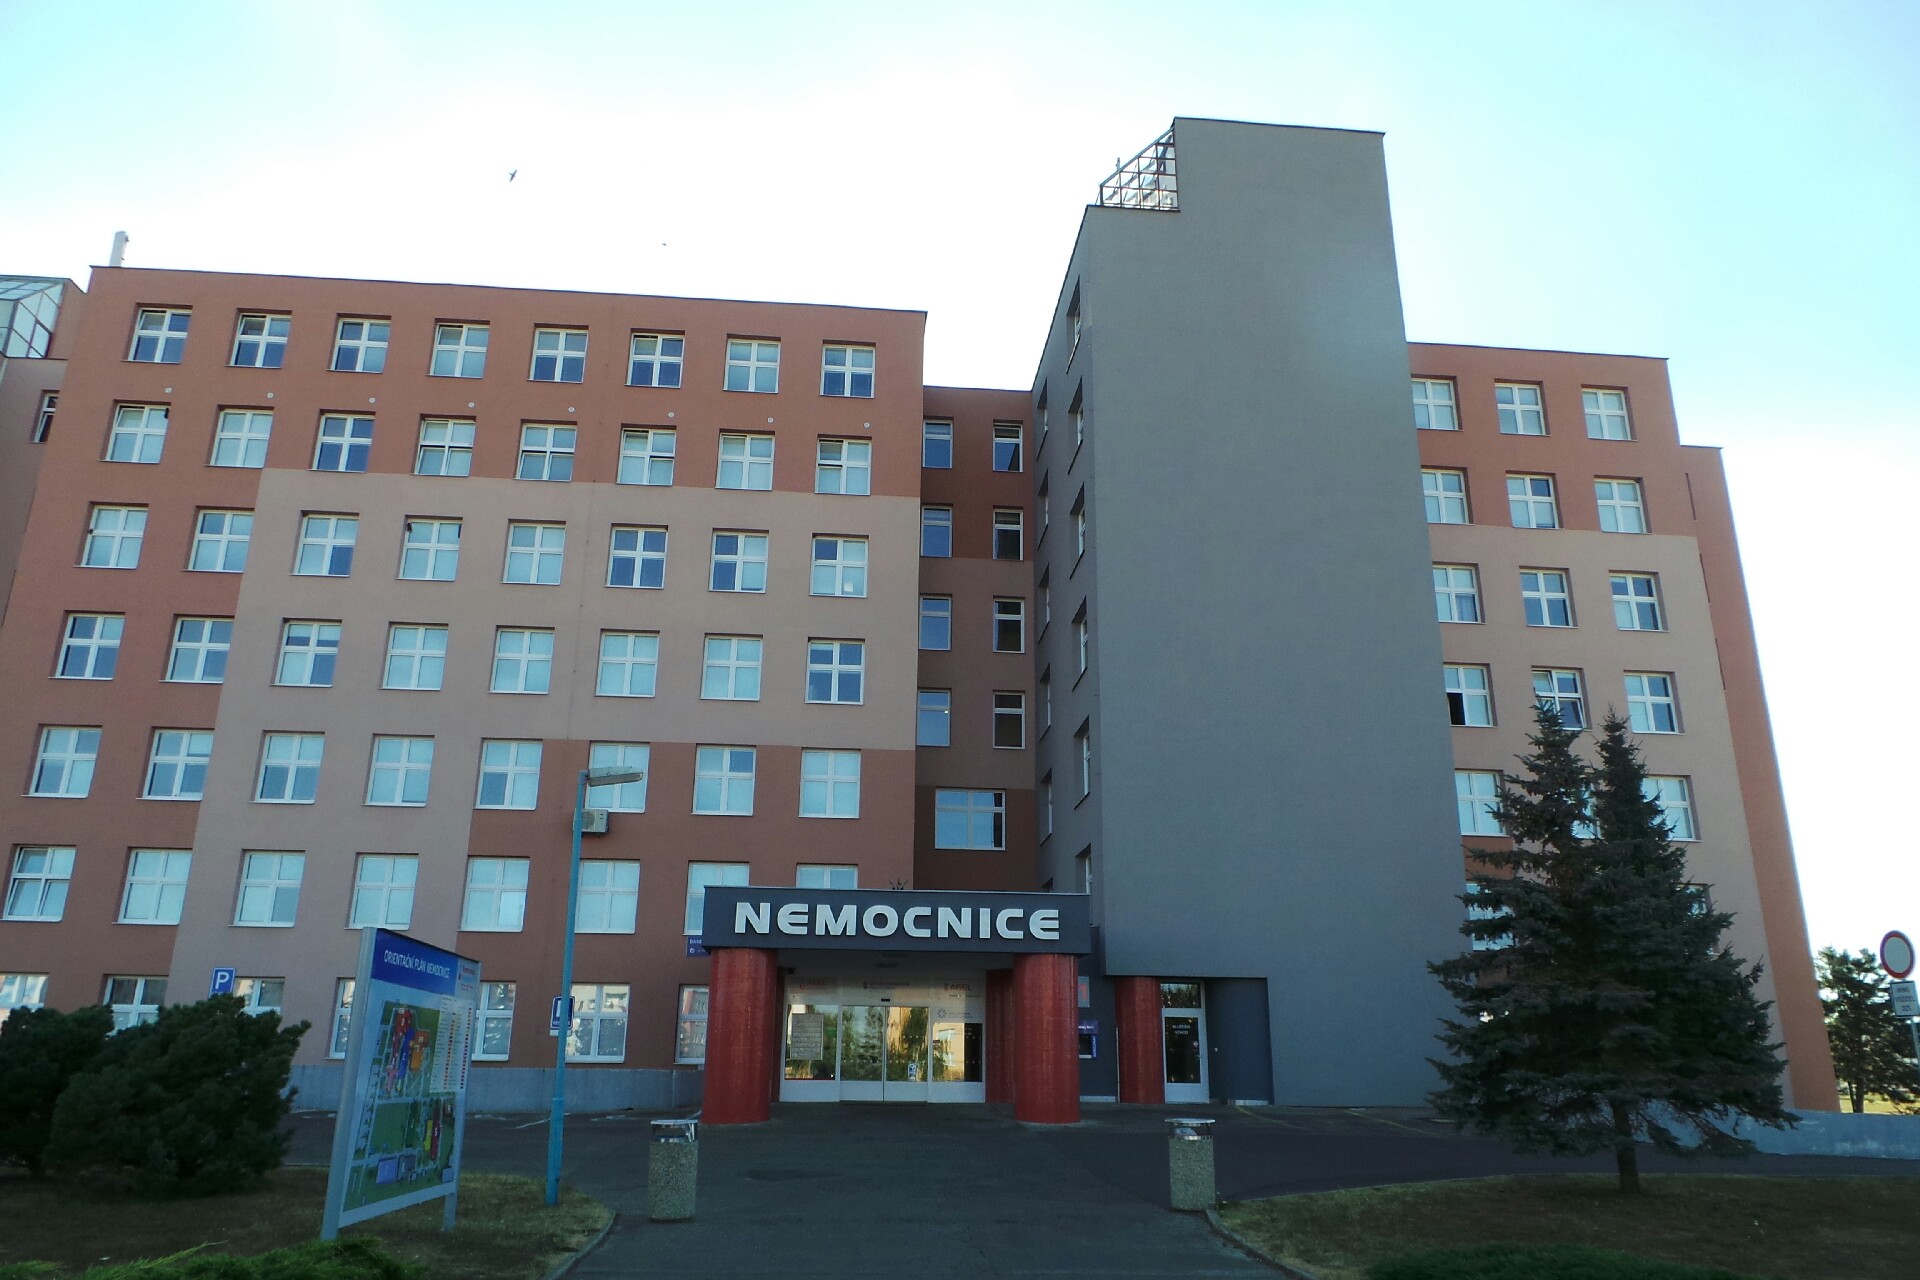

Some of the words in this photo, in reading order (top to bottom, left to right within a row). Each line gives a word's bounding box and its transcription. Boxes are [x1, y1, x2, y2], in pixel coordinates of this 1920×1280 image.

[734, 902, 1059, 939] NEMOCNICE
[384, 949, 415, 969] ORIENTAČNÍ
[415, 957, 426, 973] PLÁN
[215, 972, 230, 990] P
